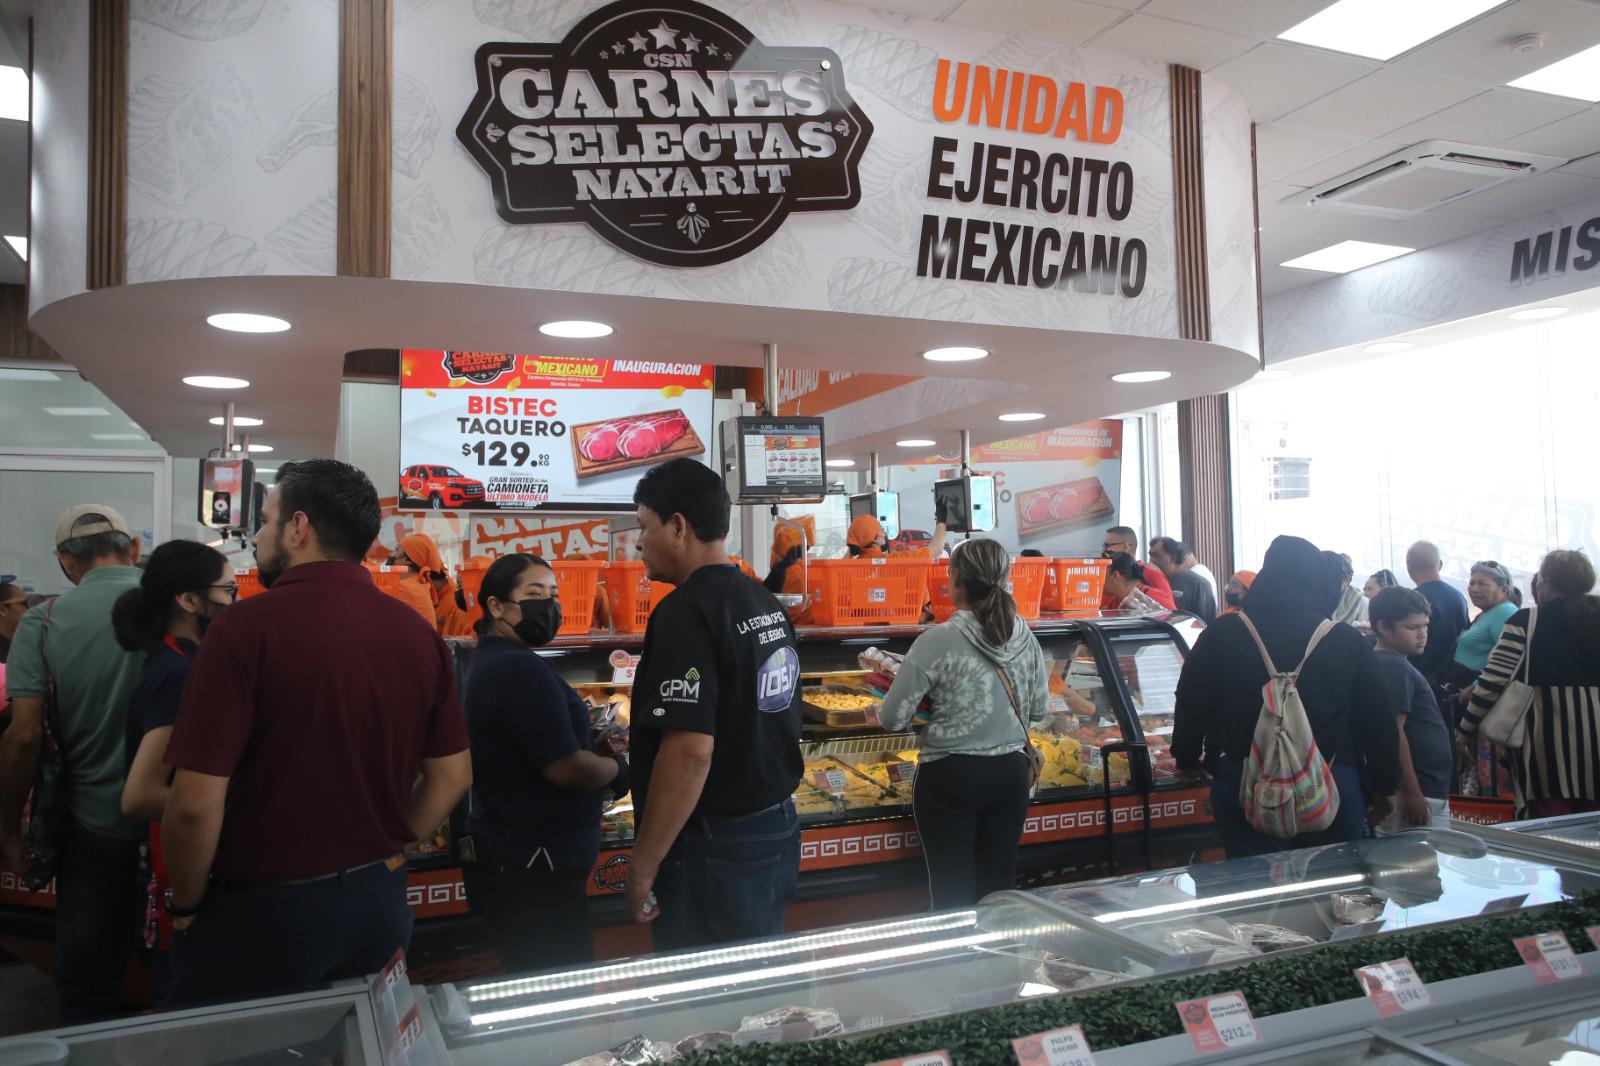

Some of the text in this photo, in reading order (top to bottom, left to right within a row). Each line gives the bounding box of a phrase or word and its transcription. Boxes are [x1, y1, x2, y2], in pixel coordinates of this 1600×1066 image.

[643, 53, 692, 68] CSN
[500, 67, 831, 120] CARNES
[932, 58, 1124, 145] UNIDAD
[507, 121, 837, 166] SELECTAS
[572, 164, 791, 201] NAYARIT
[927, 136, 1134, 222] EJERCITO
[916, 214, 1147, 298] MEXICANO
[536, 361, 599, 376] MEXICANO
[468, 395, 558, 417] BISTEC
[457, 417, 566, 438] TAQUERO
[487, 483, 549, 493] CAMIONETA
[516, 493, 549, 501] MODELO
[736, 621, 751, 635] LA
[660, 679, 700, 699] GPM
